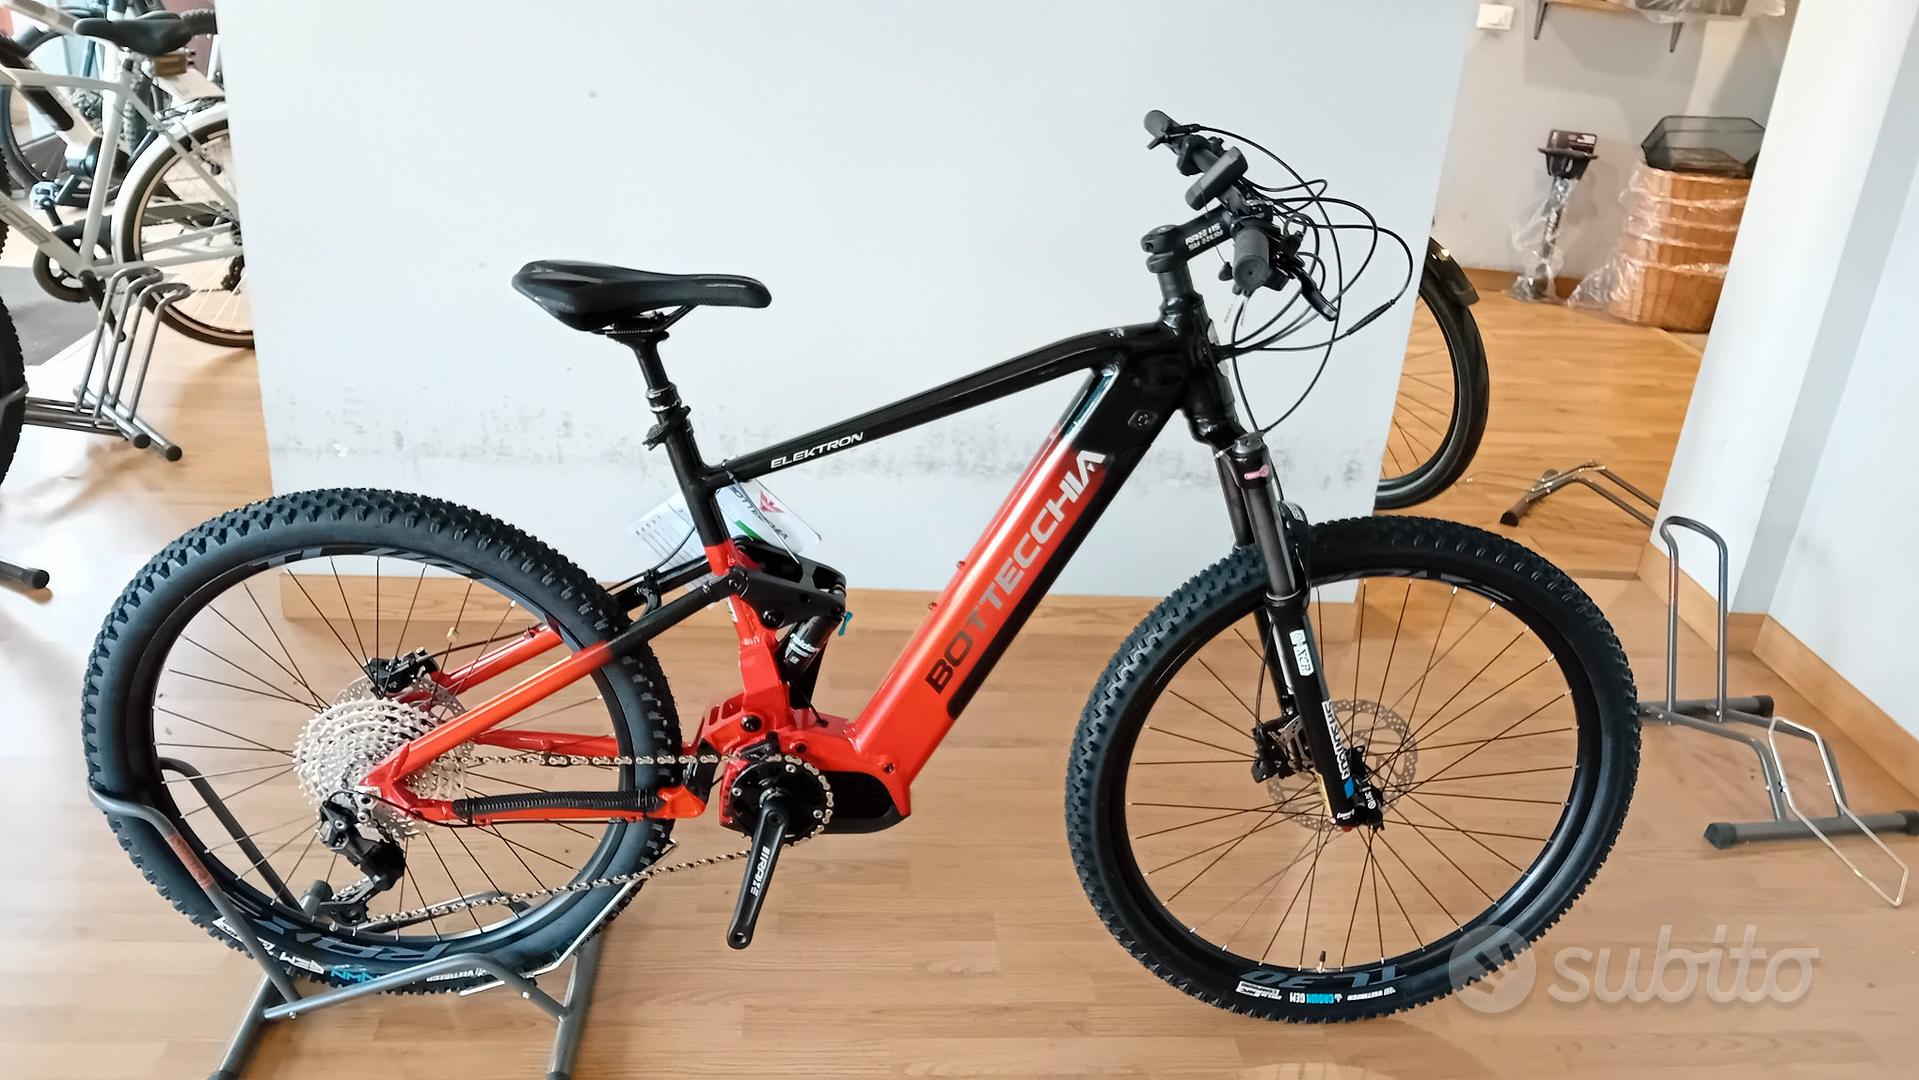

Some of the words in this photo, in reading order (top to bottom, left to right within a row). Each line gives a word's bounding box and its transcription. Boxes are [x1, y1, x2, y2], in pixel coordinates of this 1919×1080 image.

[770, 431, 864, 469] ELEKTRON
[924, 449, 1107, 695] BOTTECCHIA
[1289, 992, 1305, 1004] GEM
